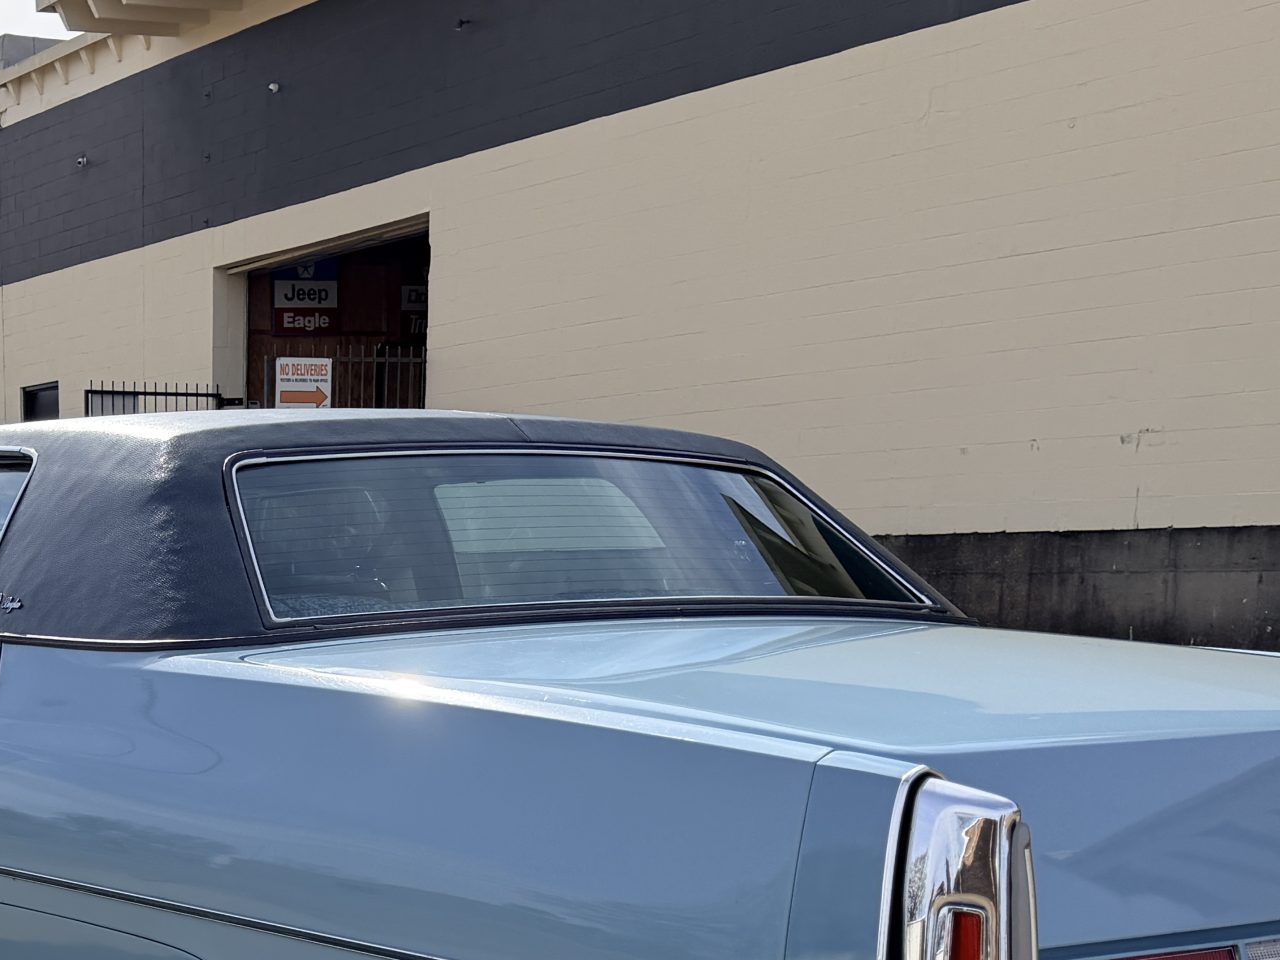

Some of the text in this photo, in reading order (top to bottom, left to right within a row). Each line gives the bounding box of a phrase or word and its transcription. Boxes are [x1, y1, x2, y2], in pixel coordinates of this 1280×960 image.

[284, 284, 329, 304] Jeep
[283, 313, 330, 331] Eagle
[280, 363, 328, 376] NO DELIVERIES
